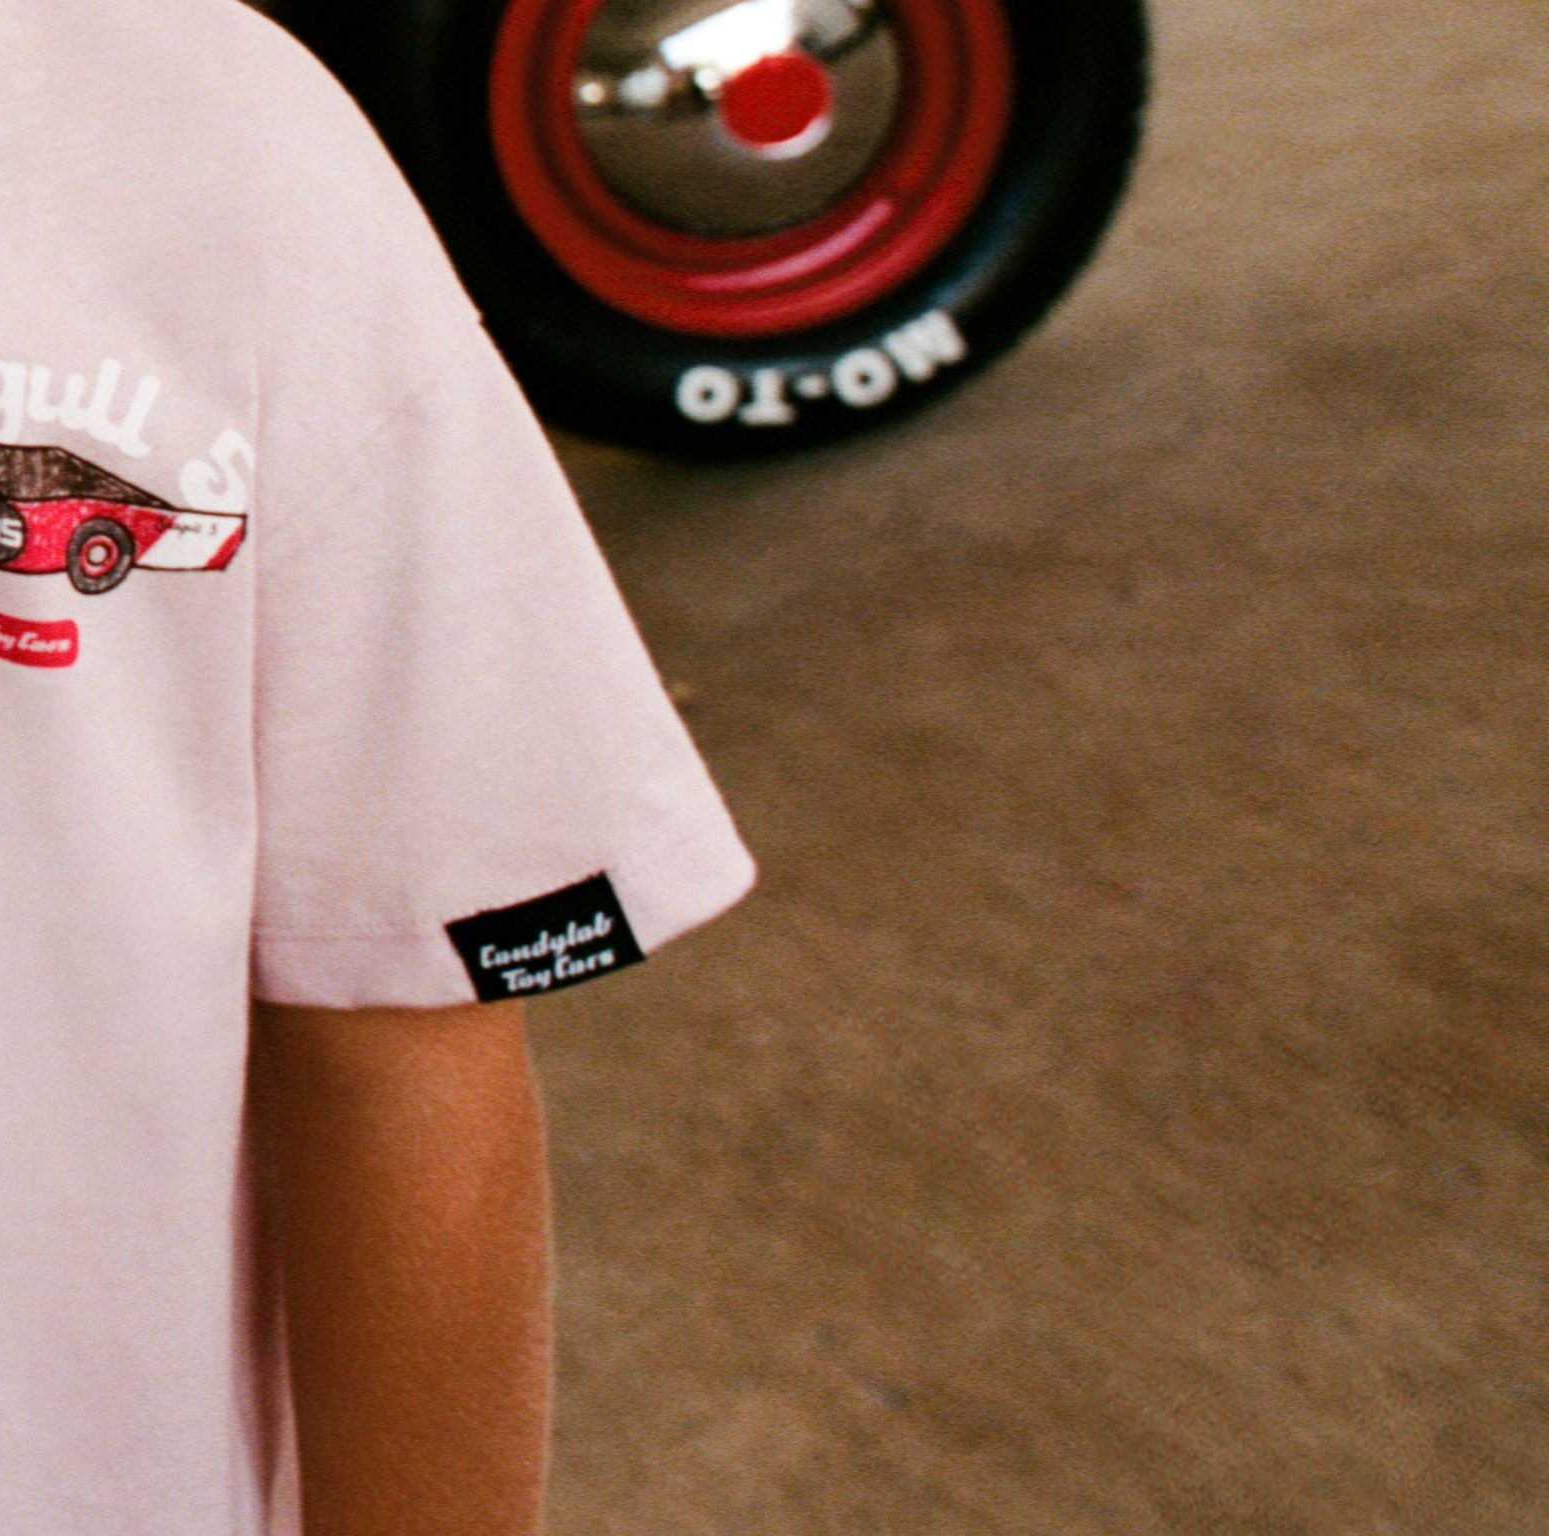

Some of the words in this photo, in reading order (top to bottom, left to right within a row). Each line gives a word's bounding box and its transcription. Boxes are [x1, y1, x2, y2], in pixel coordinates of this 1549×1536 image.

[676, 310, 966, 426] MO-TO
[18, 632, 72, 652] Cars
[479, 911, 613, 969] Candylab
[502, 967, 552, 992] Toy
[553, 947, 615, 980] Cars
